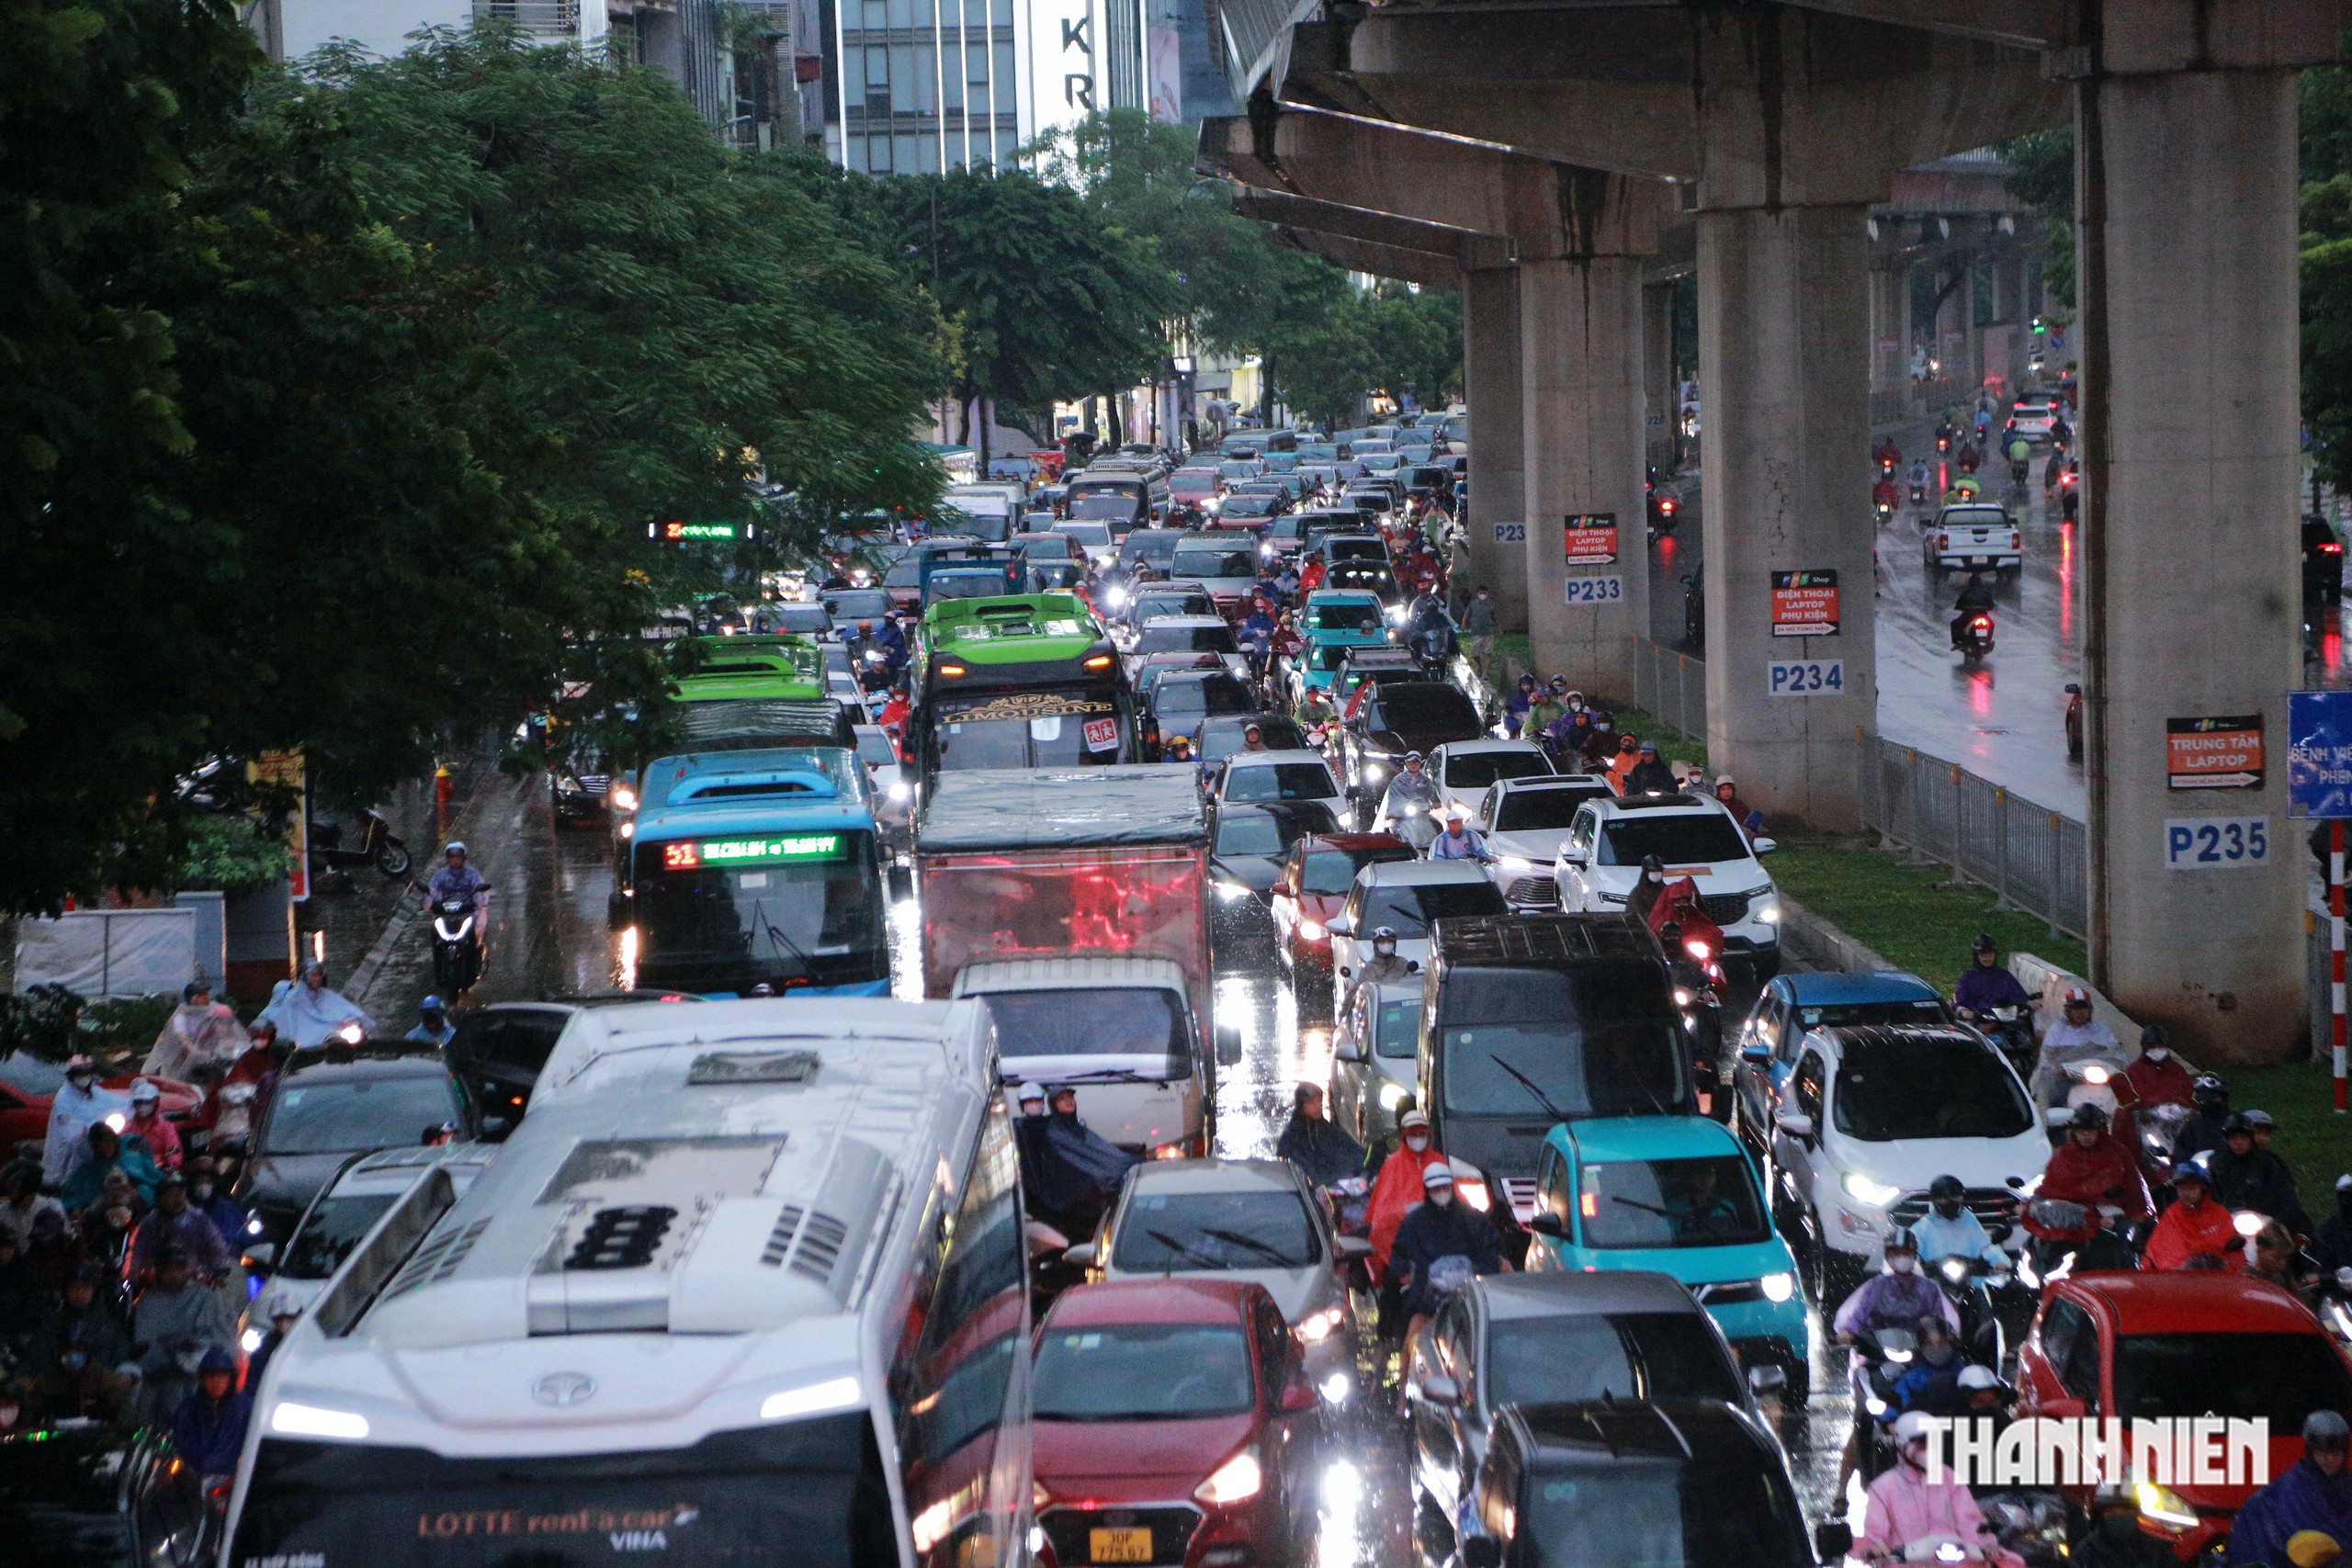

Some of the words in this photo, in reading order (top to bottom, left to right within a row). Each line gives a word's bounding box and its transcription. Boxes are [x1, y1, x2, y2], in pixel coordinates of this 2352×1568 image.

[1496, 525, 1525, 541] P23
[1782, 571, 1810, 588] FPT
[1567, 579, 1620, 601] P233
[1777, 589, 1801, 600] ĐIỆN
[1803, 590, 1835, 599] THOẠI
[1786, 601, 1826, 609] LAPTOP
[1781, 612, 1802, 622] PHỤ
[1804, 609, 1828, 620] KIỆN
[1771, 664, 1842, 692] P234
[942, 702, 1114, 724] LIMOUSINE
[2171, 738, 2226, 750] TRUNG
[2229, 734, 2259, 749] TÂM
[2187, 754, 2247, 767] LAPTOP
[2169, 822, 2267, 863] P235
[417, 1510, 519, 1538] LOTTE
[527, 1510, 589, 1534] rent
[621, 1510, 669, 1529] car
[610, 1529, 667, 1551] VINA
